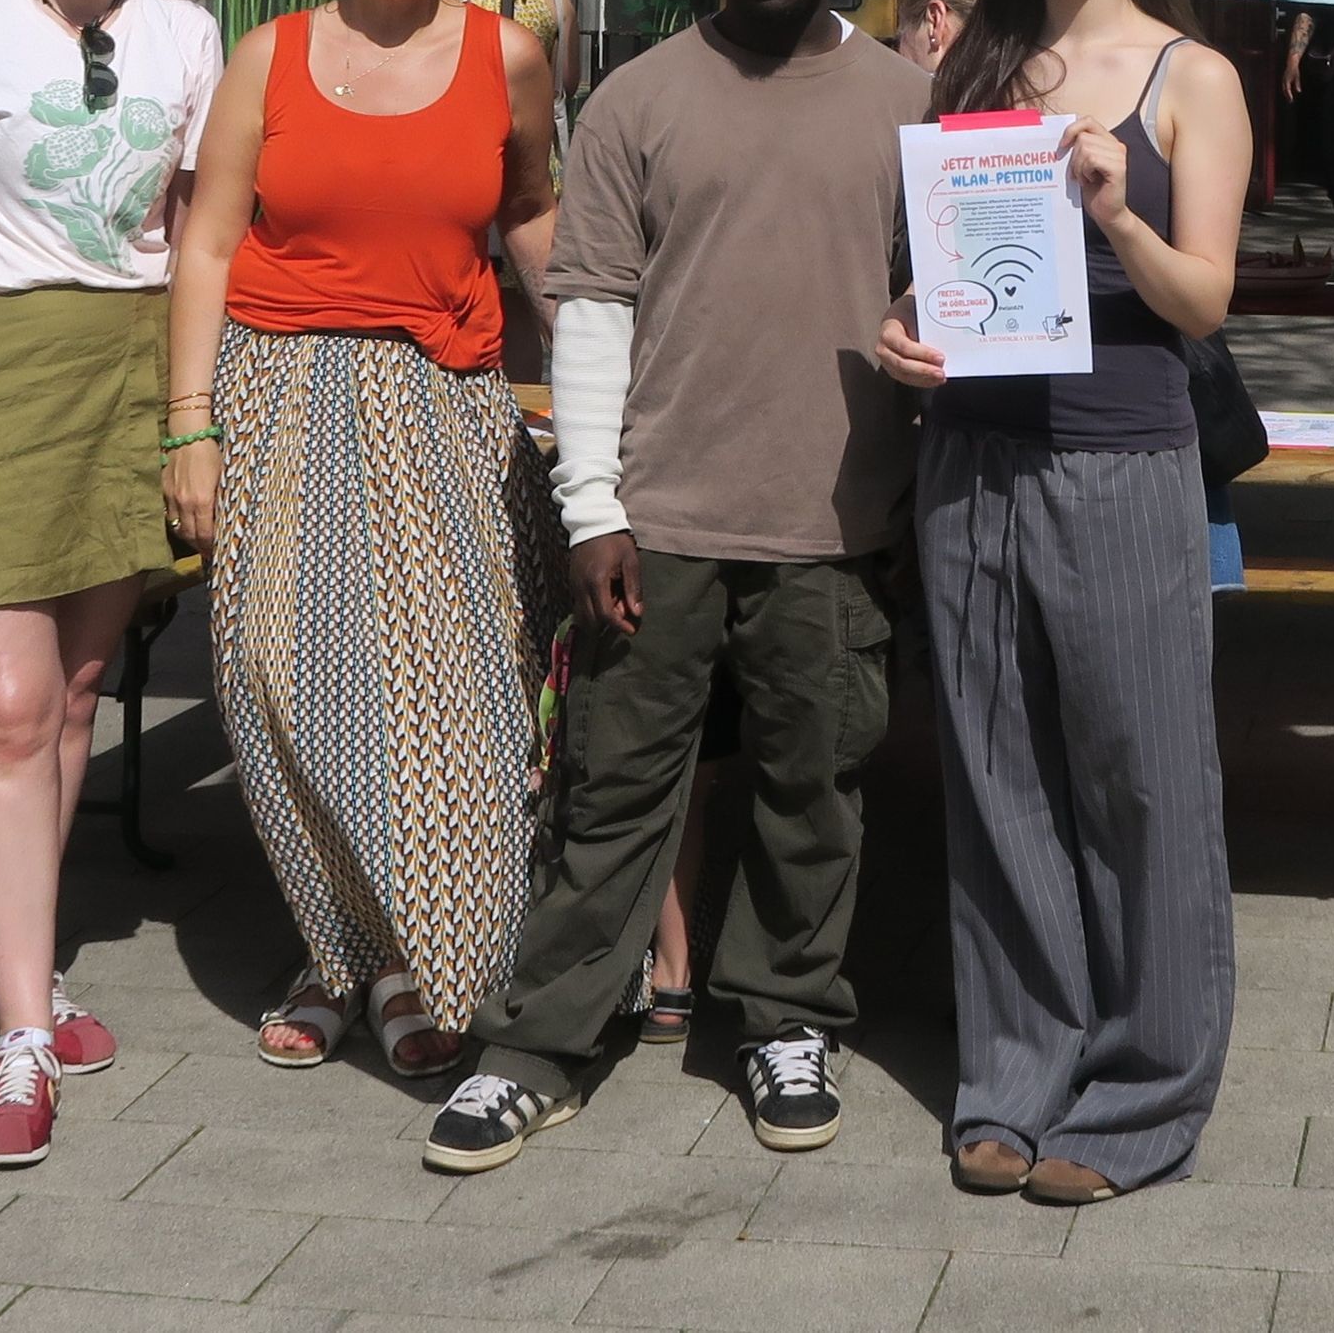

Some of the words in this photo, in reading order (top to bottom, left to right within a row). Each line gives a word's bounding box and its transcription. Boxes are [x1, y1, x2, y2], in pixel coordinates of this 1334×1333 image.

[941, 156, 975, 172] JETZT
[978, 151, 1058, 170] MITMACHEN
[950, 169, 1053, 188] WLAN-PETITION
